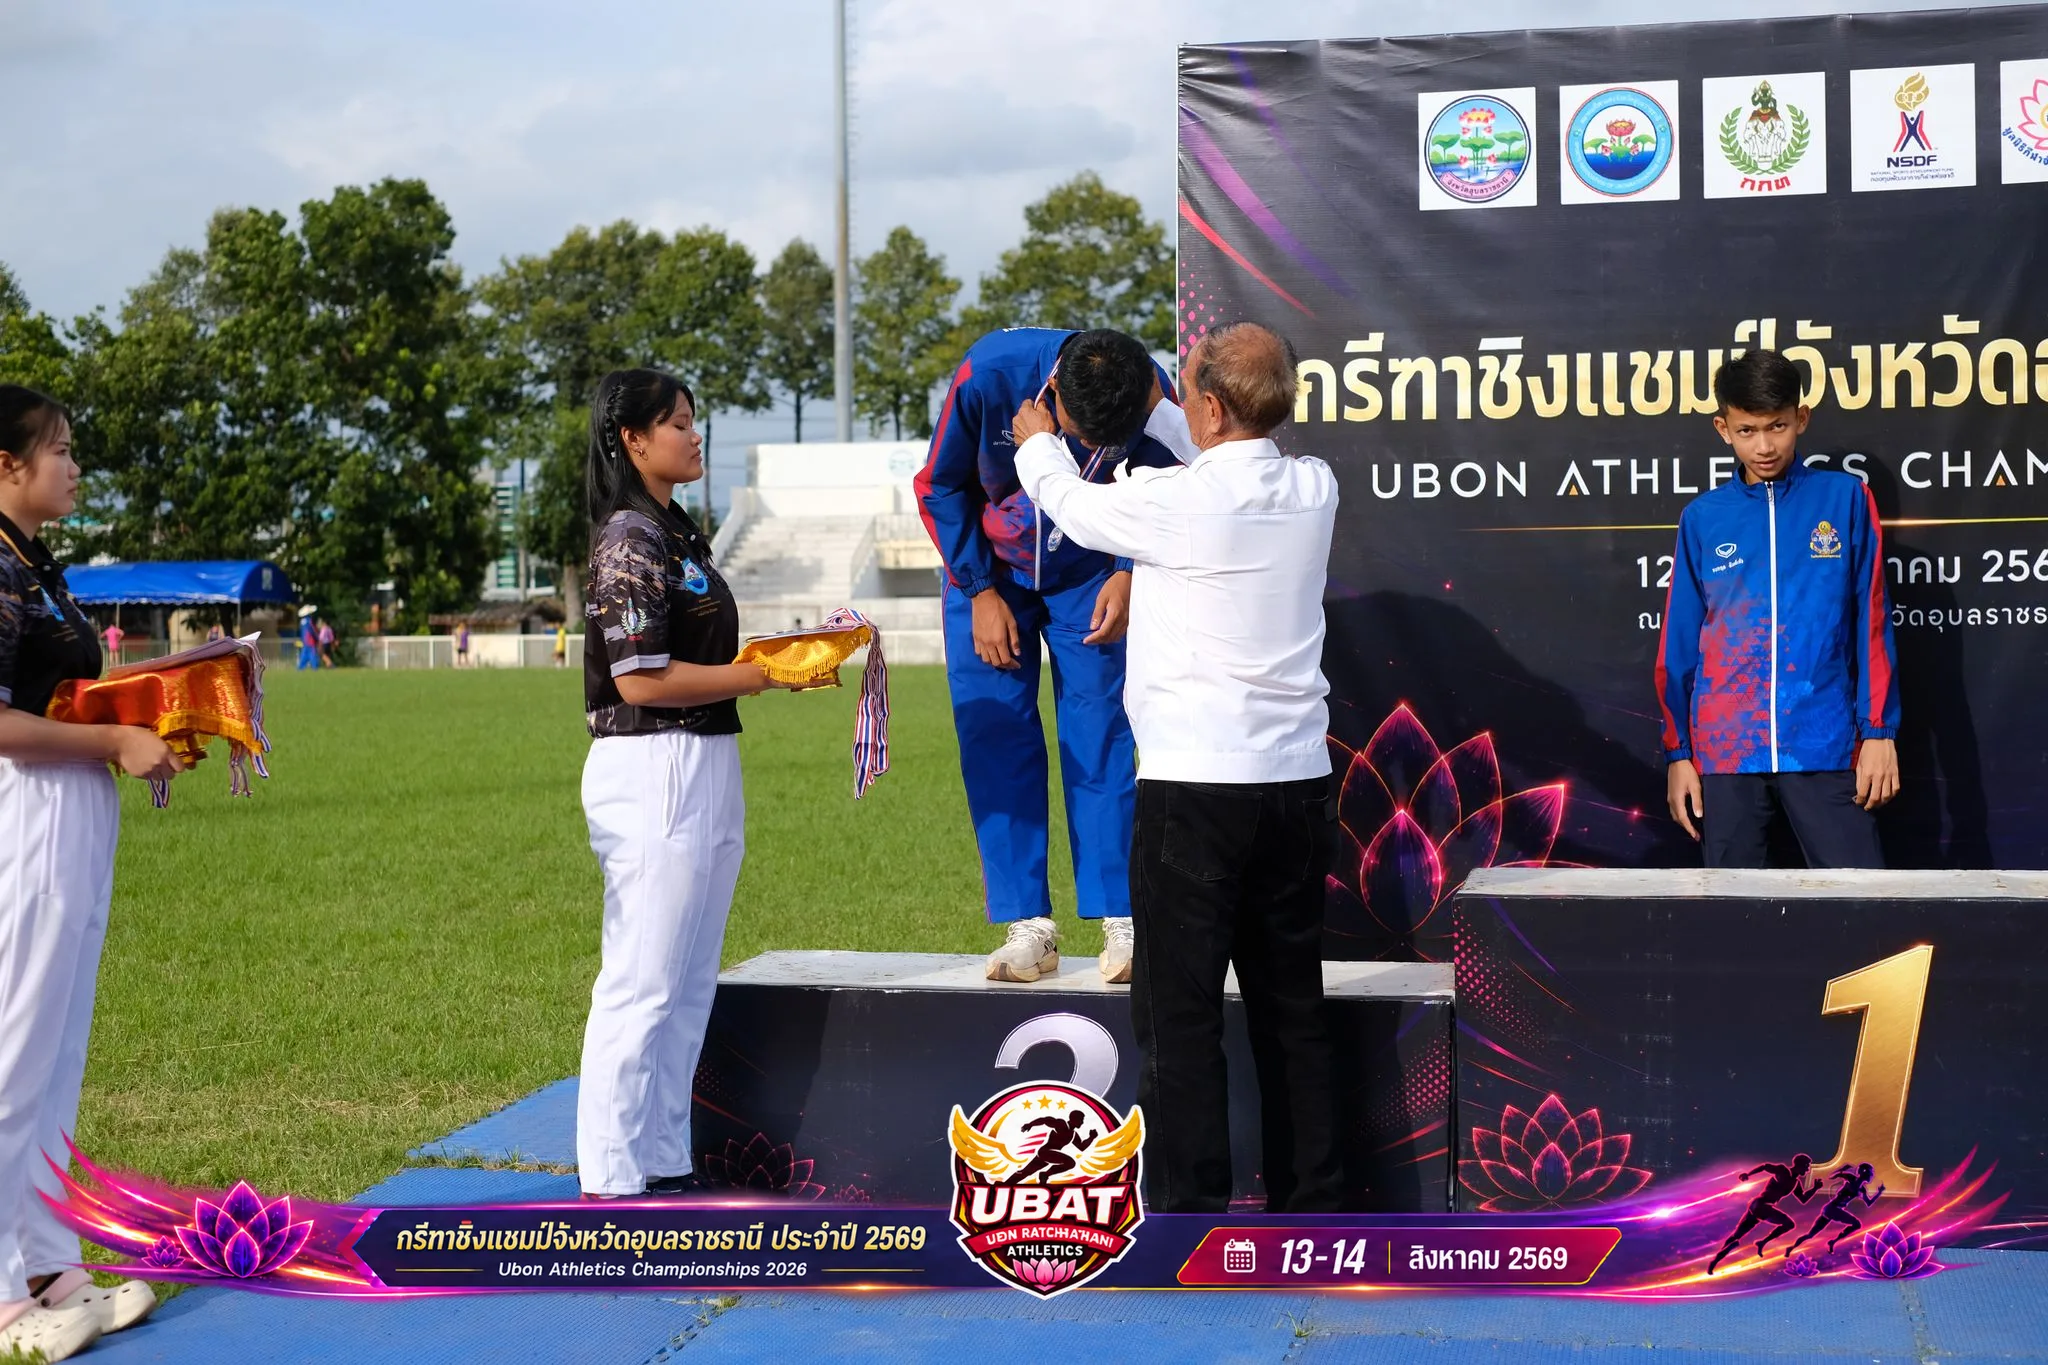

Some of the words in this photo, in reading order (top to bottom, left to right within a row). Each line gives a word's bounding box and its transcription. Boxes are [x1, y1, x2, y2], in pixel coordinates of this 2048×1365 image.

[1886, 154, 1938, 169] NSDF
[1740, 176, 1791, 192] กกท
[1372, 460, 1527, 499] UBON
[1556, 452, 1869, 497] ATHLES
[1891, 604, 2048, 634] วัดอุบลราชธ
[1806, 944, 1934, 1197] 1
